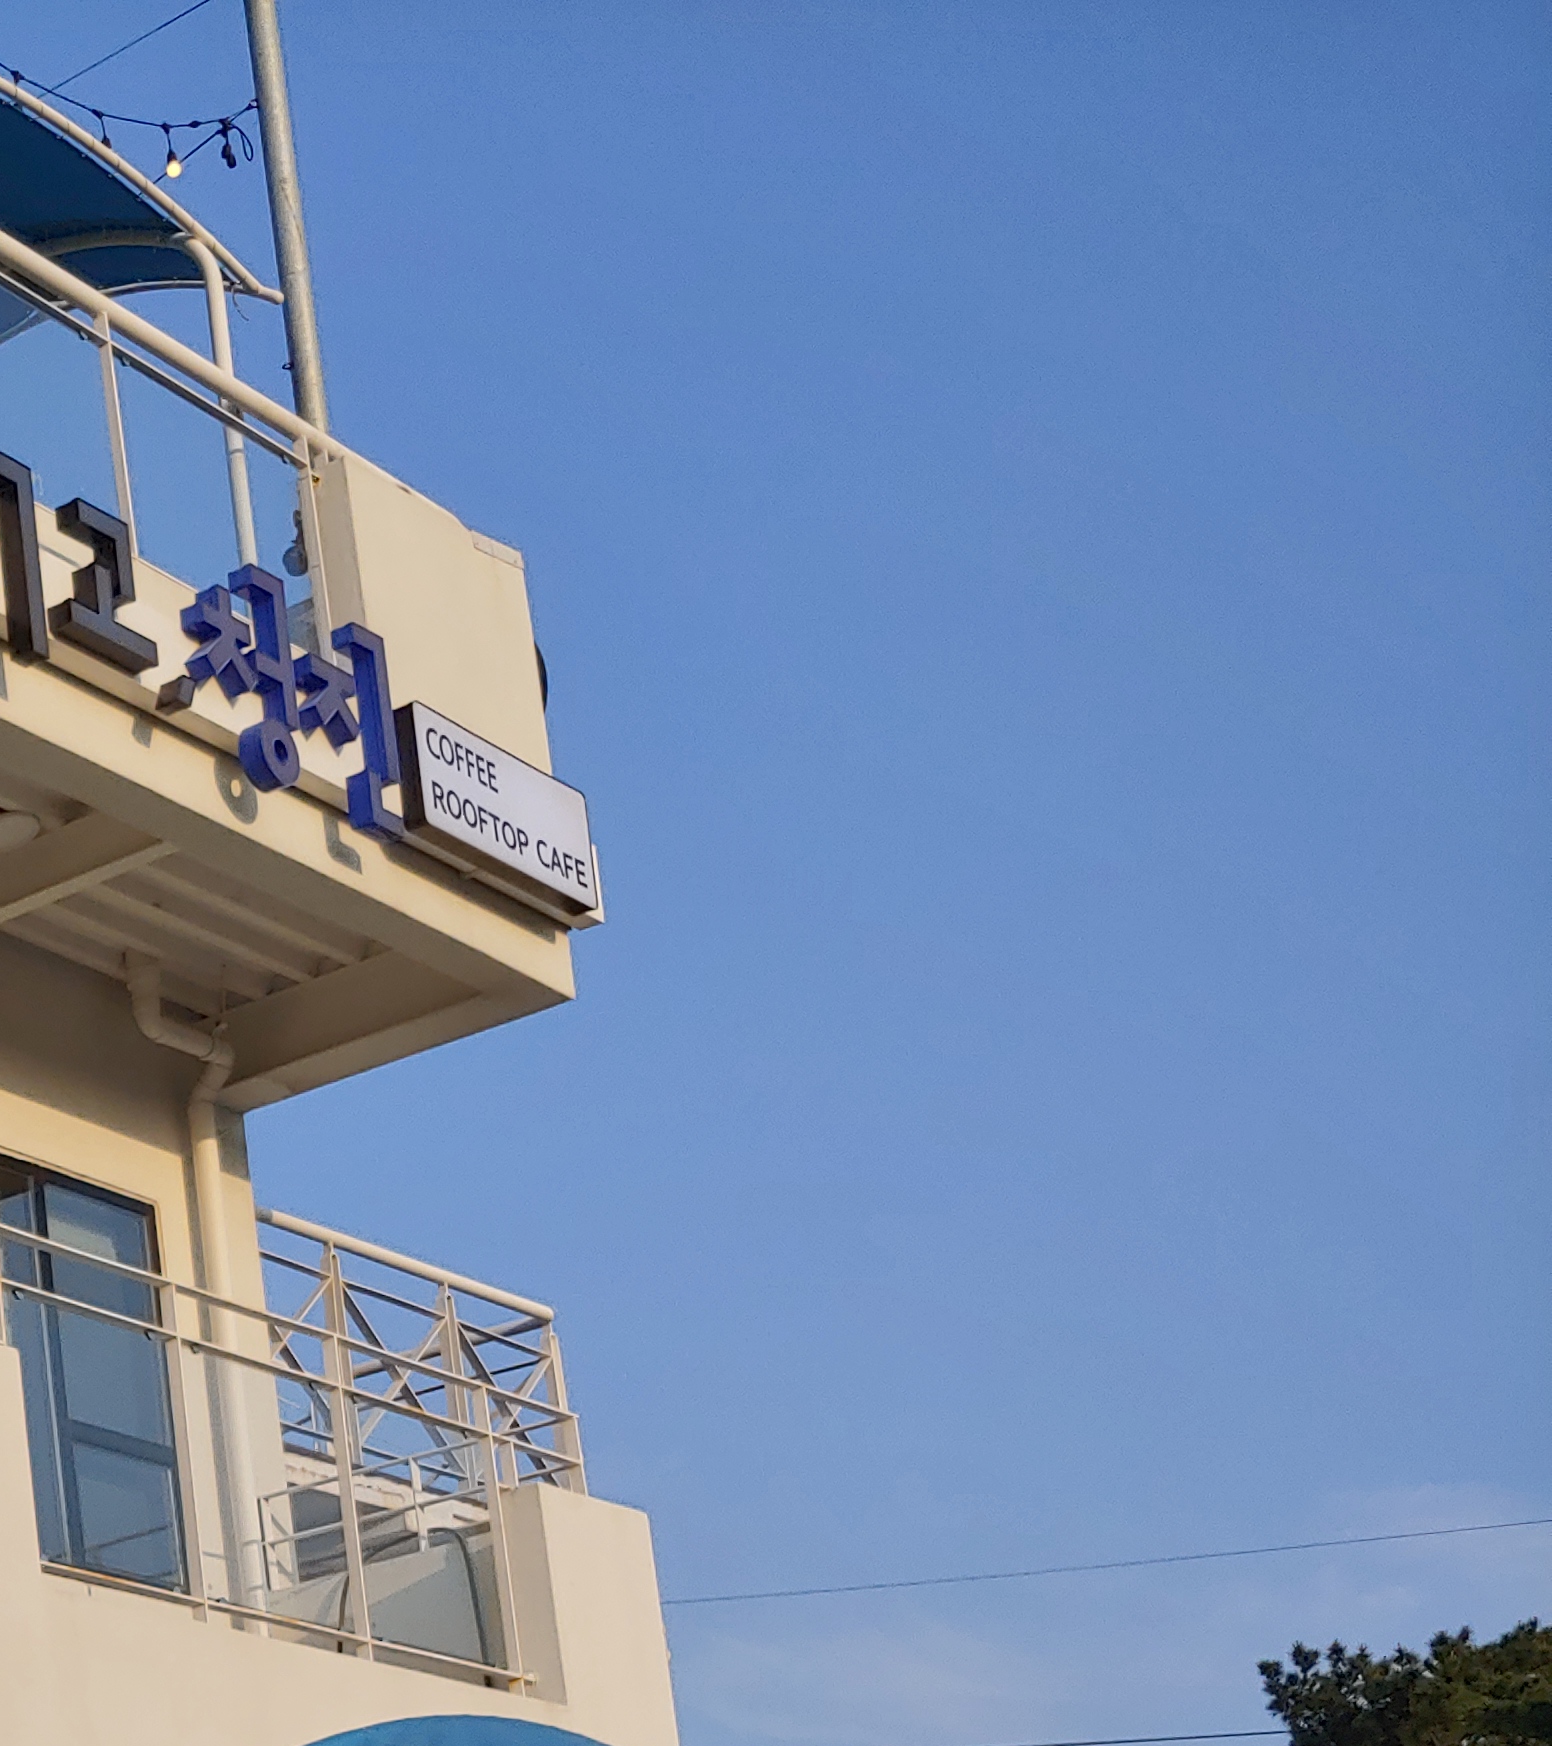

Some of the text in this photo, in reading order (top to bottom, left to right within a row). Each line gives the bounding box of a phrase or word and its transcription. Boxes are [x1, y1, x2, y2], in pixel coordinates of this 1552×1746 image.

[179, 563, 404, 842] 청진
[426, 728, 498, 793] COFFEE
[431, 780, 588, 888] ROOFTOP CAFE
